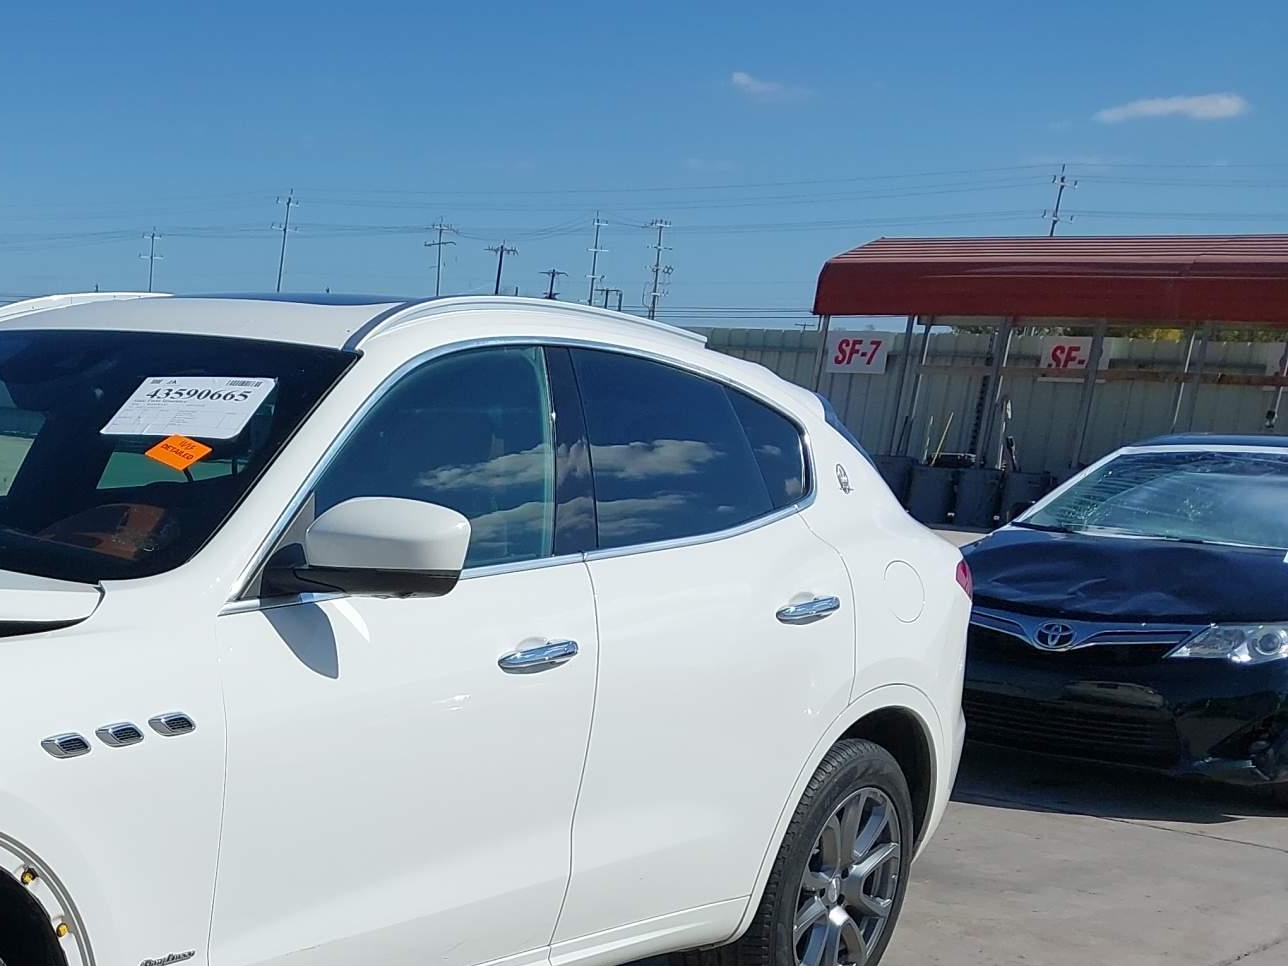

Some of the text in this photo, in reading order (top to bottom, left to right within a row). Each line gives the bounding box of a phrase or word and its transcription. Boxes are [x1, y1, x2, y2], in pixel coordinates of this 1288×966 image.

[834, 338, 883, 366] SF-7
[1047, 345, 1087, 368] SF-
[146, 388, 252, 402] 43590665
[161, 444, 194, 460] DETAILED
